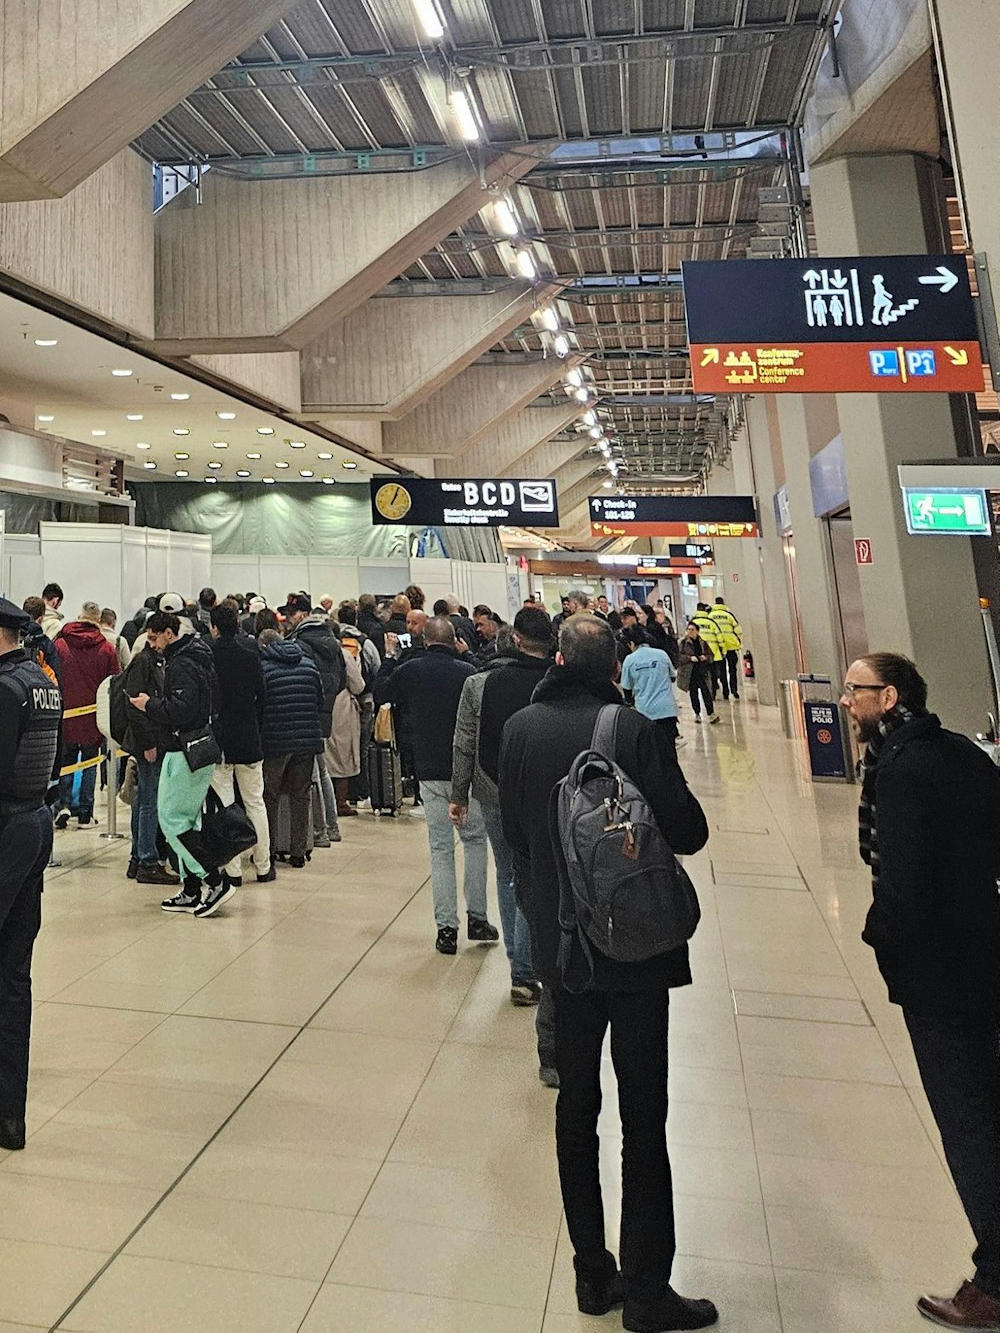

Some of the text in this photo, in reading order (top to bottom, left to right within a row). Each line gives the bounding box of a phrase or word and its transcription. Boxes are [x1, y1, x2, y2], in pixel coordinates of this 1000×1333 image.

[757, 357, 794, 365] zentrum
[870, 352, 885, 374] P
[758, 366, 804, 376] Conference
[759, 376, 787, 384] center
[812, 716, 833, 724] POLIO
